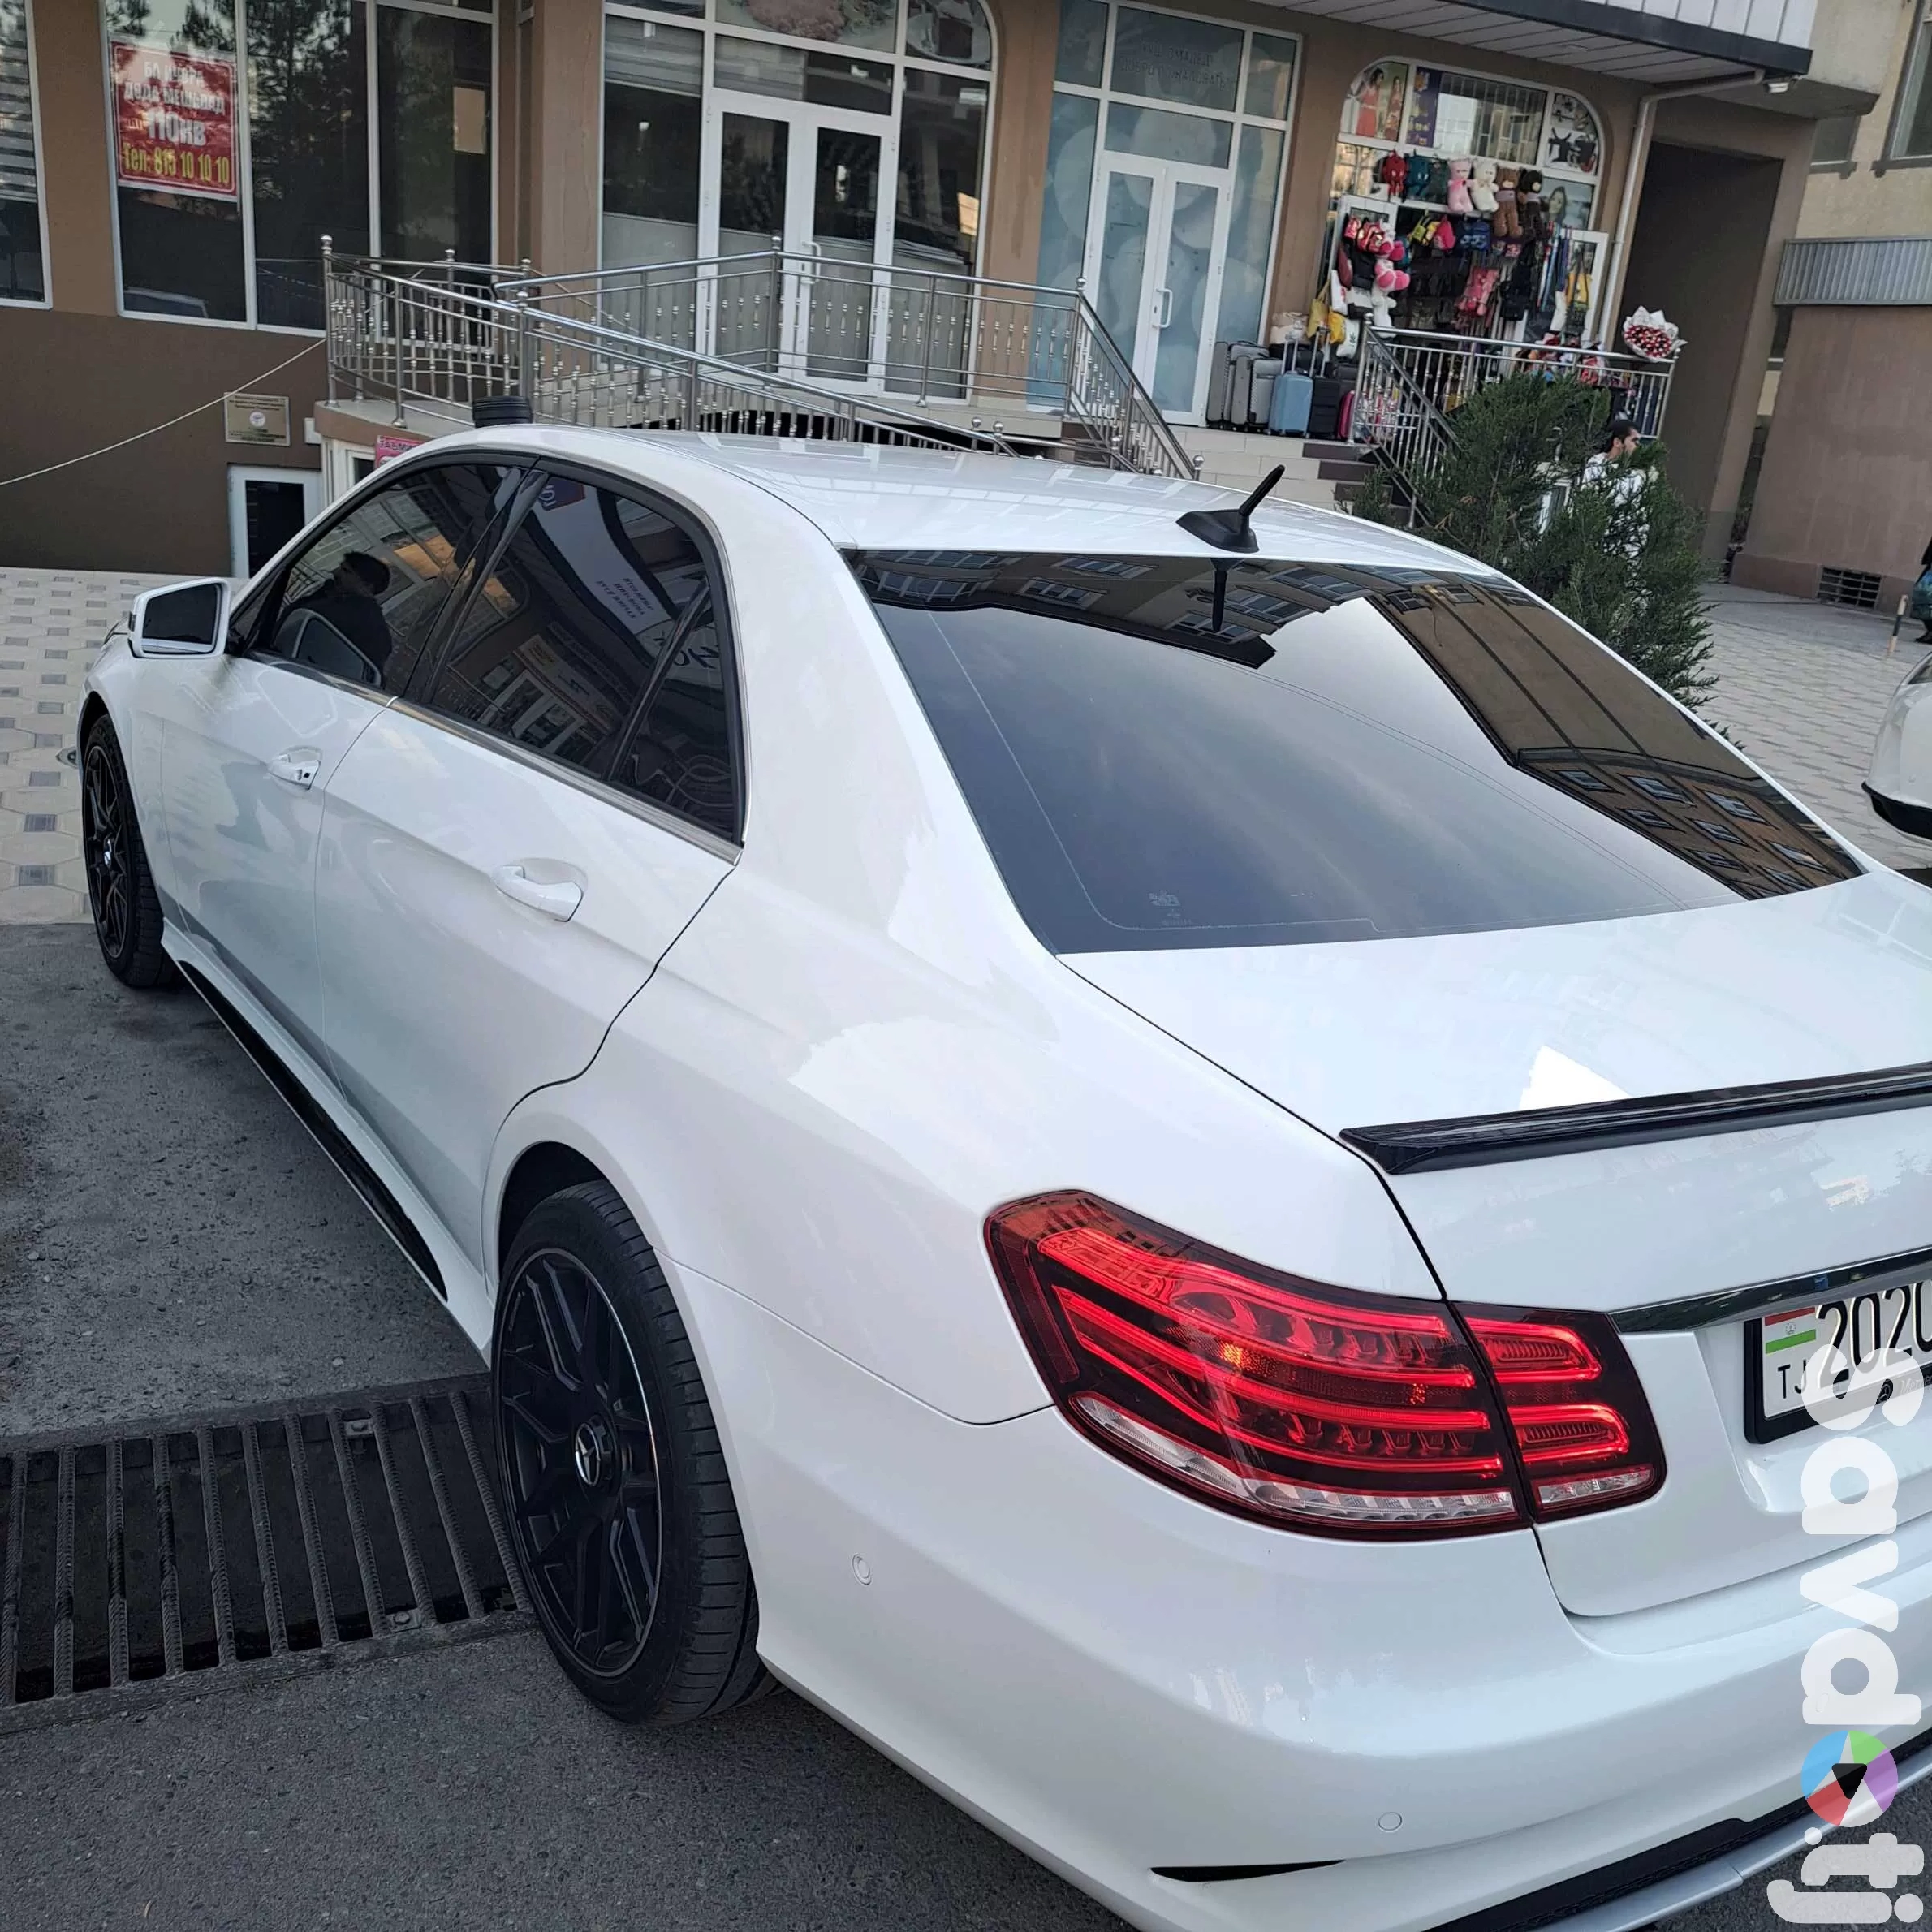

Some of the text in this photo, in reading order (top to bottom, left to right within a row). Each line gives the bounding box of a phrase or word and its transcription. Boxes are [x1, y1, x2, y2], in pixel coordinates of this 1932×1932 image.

[180, 151, 194, 179] 10
[198, 154, 212, 182] 10
[216, 157, 230, 184] 10
[1778, 1359, 1807, 1399] TJ
